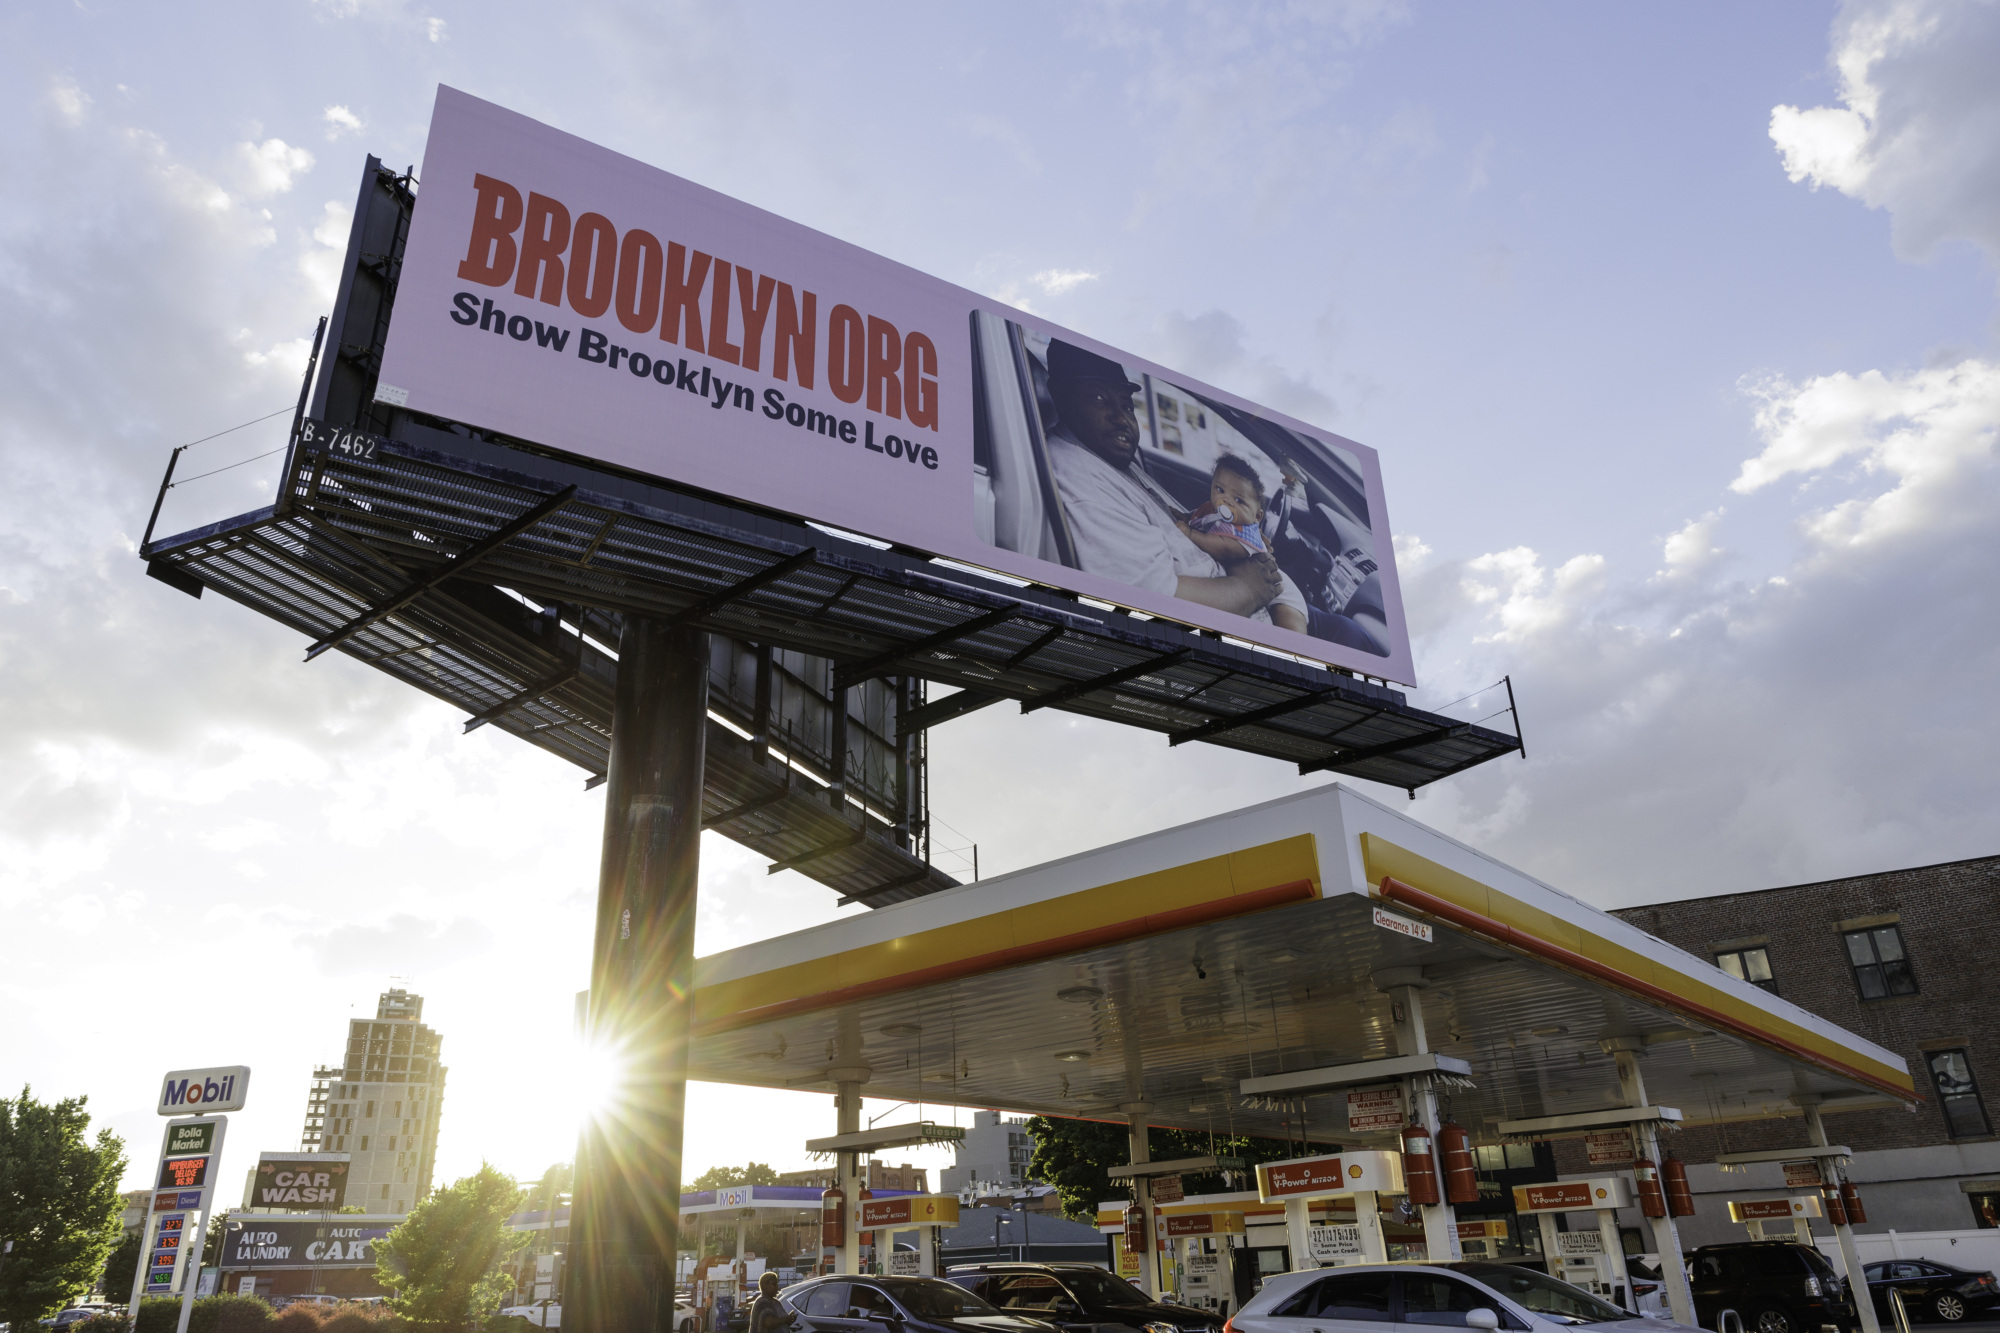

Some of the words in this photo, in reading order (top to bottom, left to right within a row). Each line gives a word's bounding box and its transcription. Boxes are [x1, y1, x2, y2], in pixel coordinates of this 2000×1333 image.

[457, 173, 815, 391] BROOKLYN
[828, 304, 939, 433] ORG
[450, 293, 571, 353] Show
[578, 328, 755, 411] Brooklyn
[762, 388, 857, 444] Some
[865, 420, 939, 470] Love
[1375, 911, 1409, 934] Clearance
[163, 1075, 235, 1106] Mobil
[1356, 1100, 1394, 1109] WARNING
[178, 1127, 203, 1139] Bolla
[925, 1126, 961, 1137] diesel
[171, 1138, 204, 1151] Market
[169, 1159, 204, 1170] HAMBURGER
[174, 1168, 197, 1178] DELUXE
[275, 1171, 330, 1187] CAR
[1273, 1179, 1309, 1188] V-Power
[180, 1196, 198, 1205] Diesel
[261, 1187, 336, 1203] WASH
[719, 1189, 748, 1207] Mobil
[925, 1202, 935, 1215] 6
[866, 1213, 889, 1221] V-Power
[1224, 1218, 1232, 1228] 4
[239, 1231, 278, 1245] AUTO
[1950, 1238, 1957, 1246] P
[236, 1246, 292, 1260] LAUNDRY
